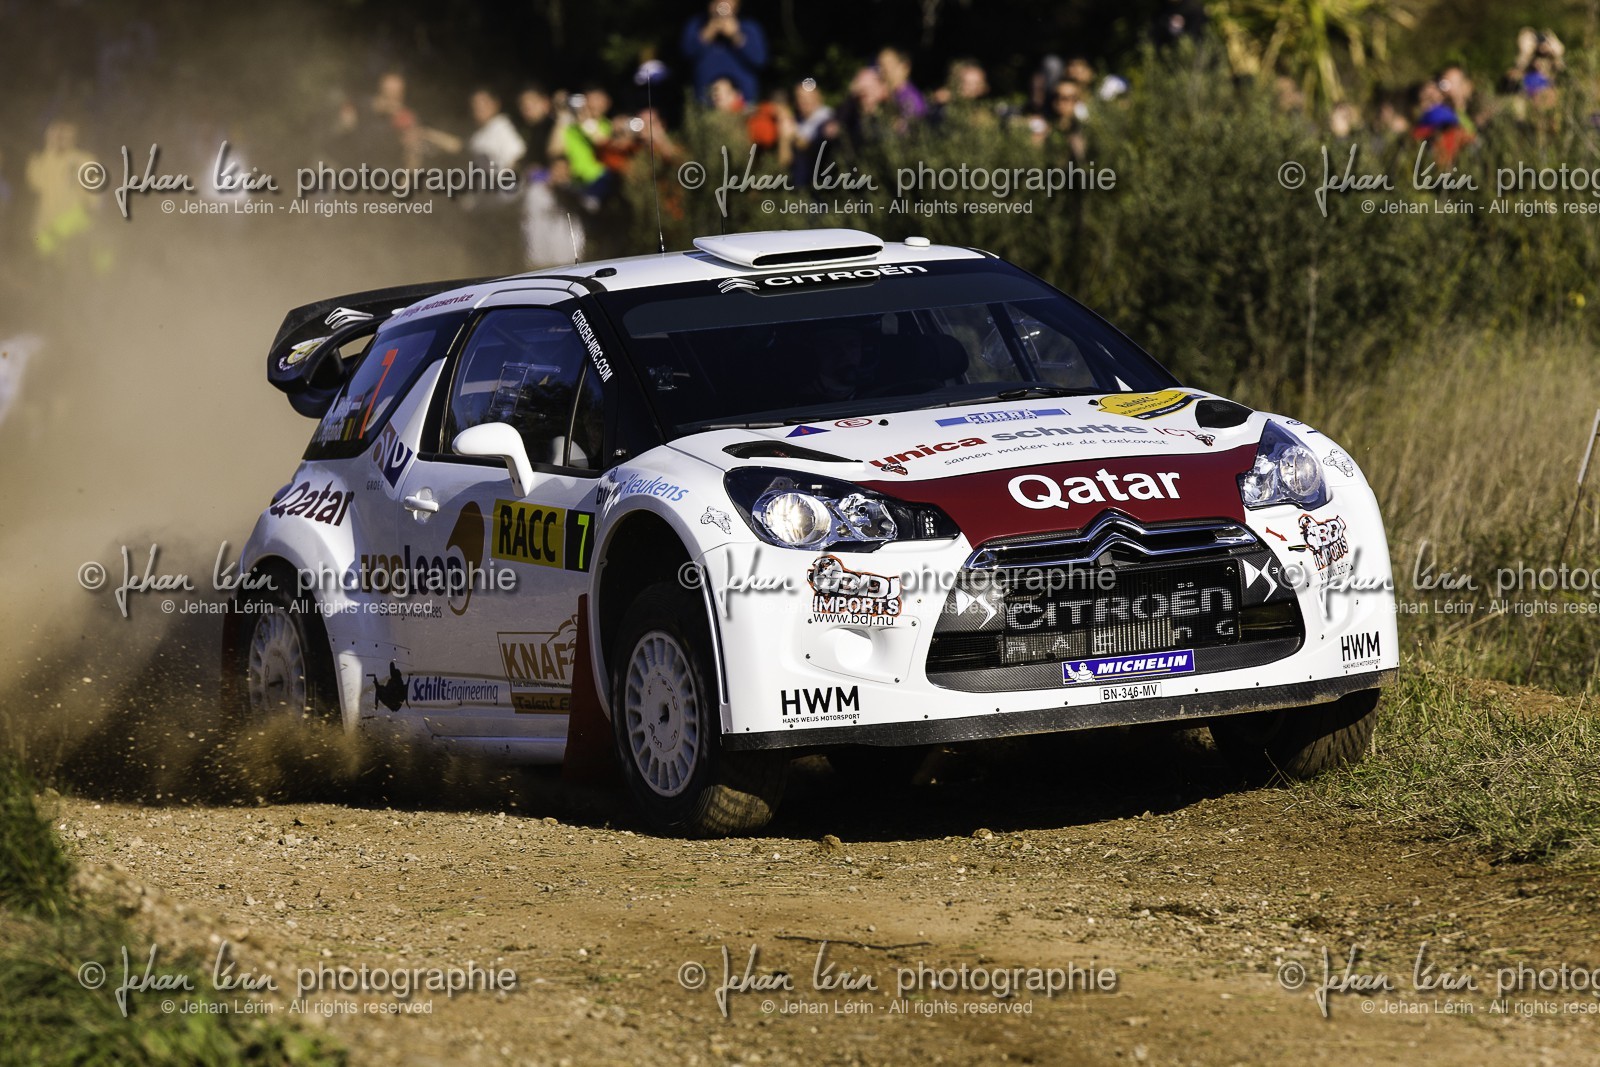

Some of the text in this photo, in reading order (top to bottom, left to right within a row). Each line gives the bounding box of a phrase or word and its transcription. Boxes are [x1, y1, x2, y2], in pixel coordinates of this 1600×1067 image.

[764, 264, 928, 287] CITROËN
[869, 424, 1196, 469] unica schutte ICT
[944, 451, 993, 466] samen
[997, 440, 1048, 454] maken
[1007, 468, 1181, 510] Qatar
[270, 480, 355, 526] Qatar
[499, 504, 590, 570] RACC 7
[813, 595, 900, 616] IMPORTS
[813, 613, 894, 627] www.bdj.nu
[1341, 631, 1380, 661] HWM
[501, 643, 568, 680] KNAF
[1096, 654, 1187, 675] MICHELIN
[515, 696, 555, 711] Talent
[780, 685, 861, 716] HWM
[1102, 683, 1158, 700] BN-346-MV
[801, 715, 820, 723] WEIJS
[820, 713, 861, 721] MOTORSPORT
